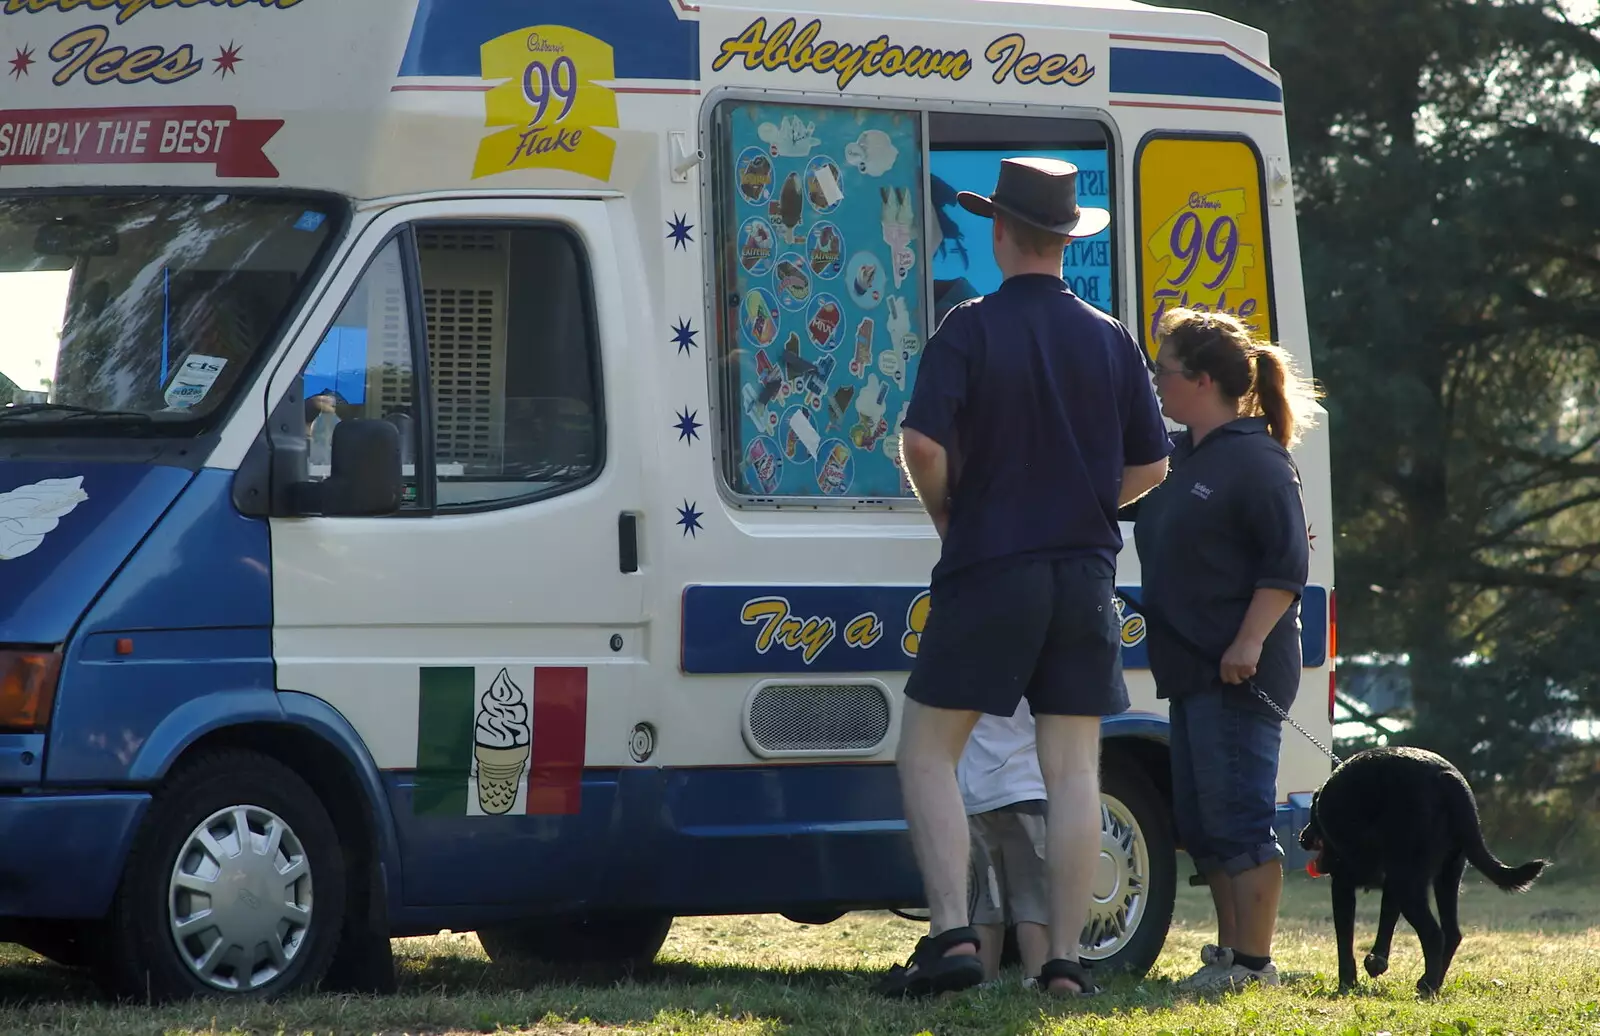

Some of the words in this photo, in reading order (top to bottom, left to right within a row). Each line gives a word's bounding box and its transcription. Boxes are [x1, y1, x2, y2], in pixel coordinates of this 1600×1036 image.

[48, 24, 204, 87] Ices
[526, 32, 565, 55] Cadbury's
[711, 16, 972, 91] Abbeytown
[984, 32, 1095, 87] Ices
[522, 55, 578, 128] 99
[0, 121, 91, 157] SIMPLY
[95, 120, 151, 155] THE
[159, 119, 231, 154] BEST
[506, 126, 583, 167] Flake
[1187, 191, 1222, 212] Cadbury's
[1166, 211, 1240, 291] 99
[1152, 289, 1260, 344] Flke
[186, 362, 220, 372] CIS
[740, 596, 836, 665] Try
[843, 611, 883, 650] a
